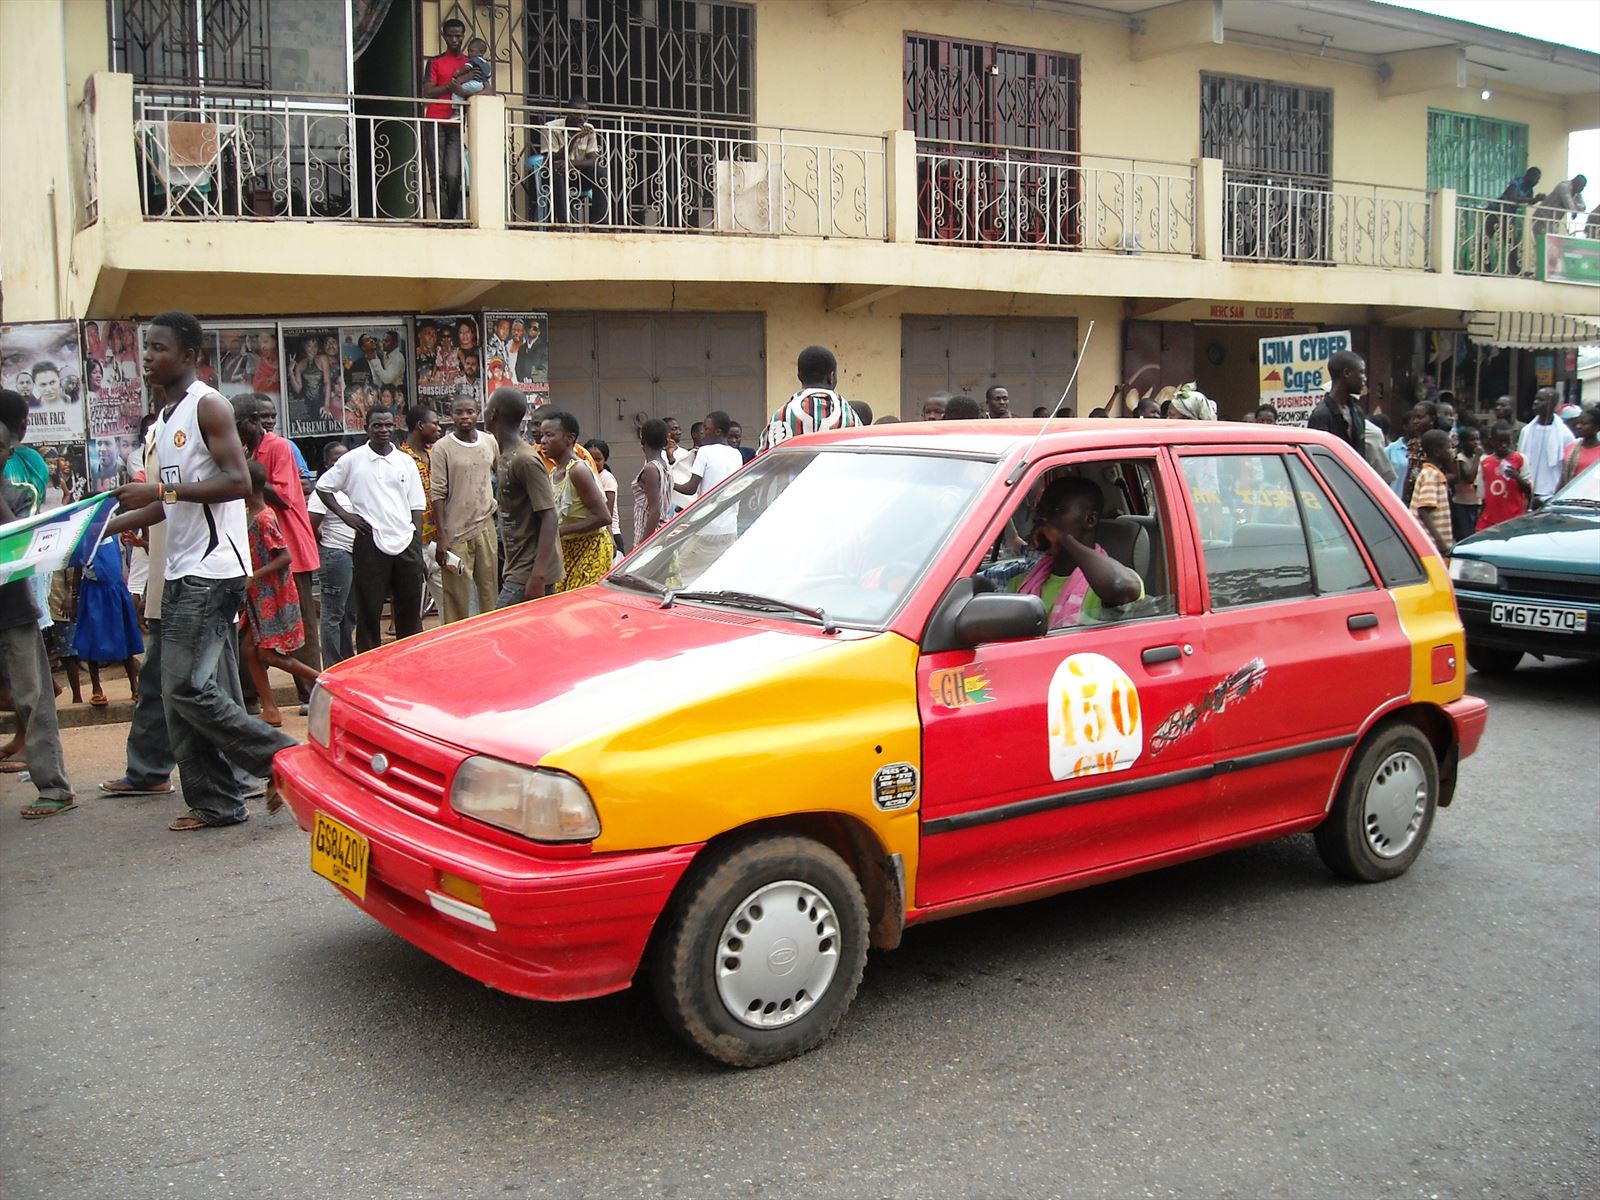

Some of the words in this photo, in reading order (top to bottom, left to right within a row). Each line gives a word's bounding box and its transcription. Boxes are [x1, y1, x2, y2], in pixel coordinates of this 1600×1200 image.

[1255, 306, 1273, 320] COLD
[1299, 335, 1348, 362] CYBER
[1277, 395, 1313, 408] BUSINESS
[49, 410, 66, 425] FACE
[291, 420, 327, 434] EXTREME
